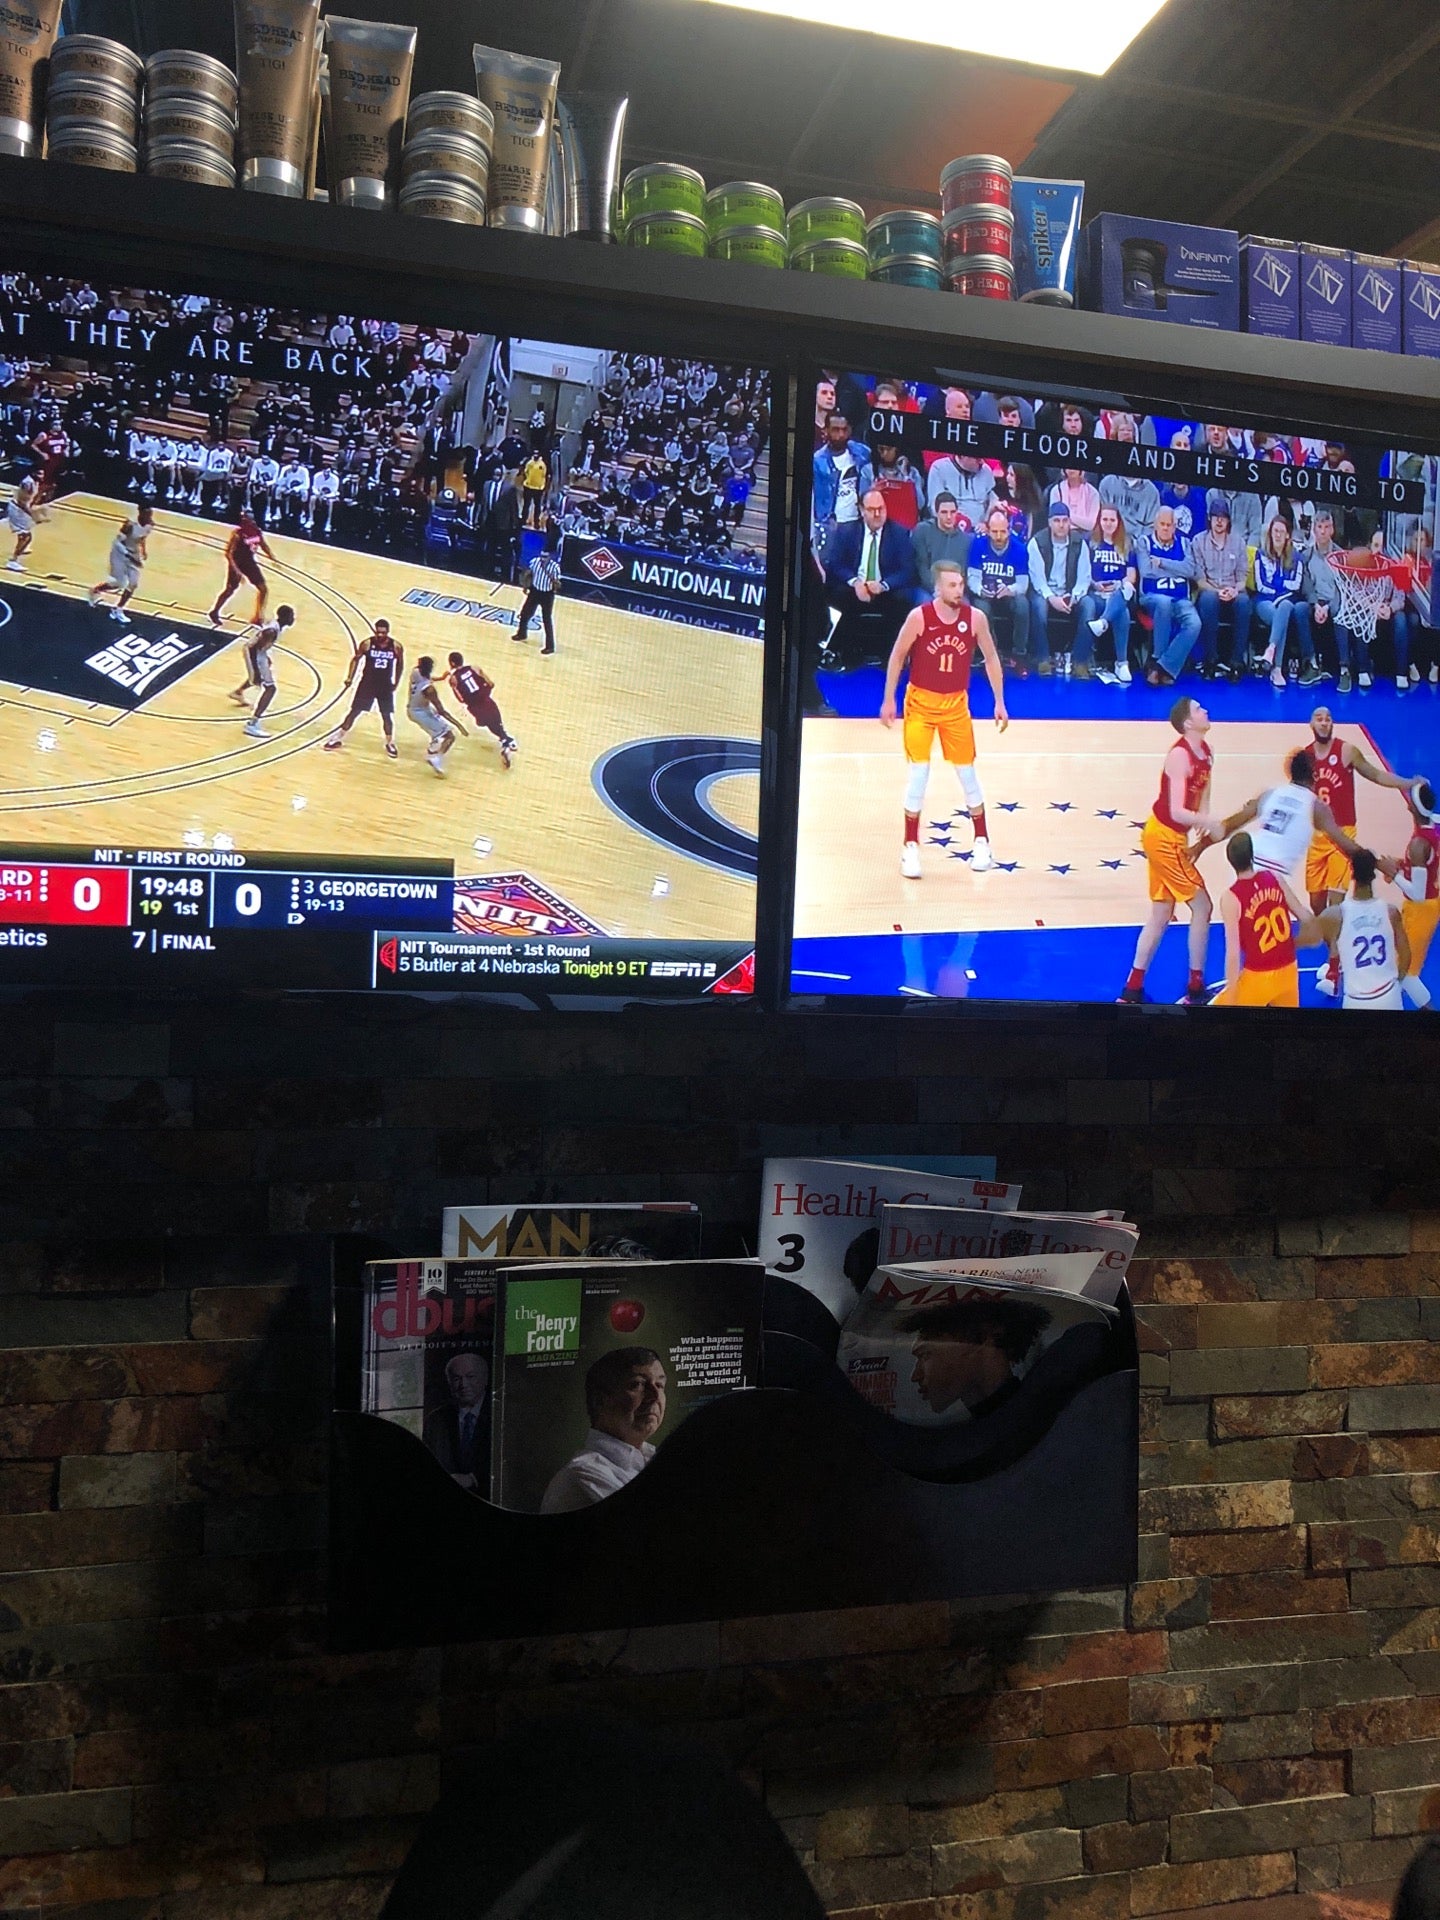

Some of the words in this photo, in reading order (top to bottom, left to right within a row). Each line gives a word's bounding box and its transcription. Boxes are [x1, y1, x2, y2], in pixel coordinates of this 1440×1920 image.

[367, 75, 401, 87] HEAD
[495, 102, 520, 115] BED
[521, 107, 543, 119] HEA
[1033, 210, 1053, 268] spiker
[1188, 251, 1233, 264] INFINITY
[977, 278, 1005, 292] HEAD
[65, 318, 157, 352] THEY
[188, 335, 254, 365] ARE
[286, 347, 372, 379] BACK
[870, 411, 904, 435] ON
[929, 419, 979, 445] THE
[1003, 429, 1104, 465] FLOOR,
[1127, 446, 1176, 472] AND
[1197, 456, 1260, 482] HE'S
[1280, 469, 1357, 497] GOING
[1379, 480, 1406, 503] TO
[631, 560, 736, 601] NATIONAL
[741, 583, 766, 607] IN
[84, 633, 151, 675] BIG
[107, 632, 189, 688] EAST
[374, 658, 389, 669] 23
[939, 653, 953, 673] 11
[1318, 787, 1331, 806] 6
[95, 849, 122, 863] NIT
[137, 851, 182, 865] FIRST
[186, 854, 246, 867] ROUND
[0, 869, 33, 886] RD
[73, 877, 101, 911] 0
[140, 878, 204, 897] 19:48
[304, 881, 314, 895] 3
[319, 881, 438, 899] GEORGETOWN
[140, 900, 162, 916] 19
[174, 900, 199, 916] 1st
[235, 882, 262, 915] 0
[304, 898, 345, 912] 19-13
[0, 930, 48, 947] etics
[1253, 906, 1291, 954] 20
[132, 931, 147, 949] 7
[163, 935, 216, 951] FINAL
[400, 940, 427, 955] NIT
[429, 940, 512, 957] Tournament
[524, 943, 544, 957] 1st
[547, 944, 590, 958] Round
[1352, 934, 1387, 969] 23
[400, 957, 410, 972] 5
[413, 957, 458, 974] Butler
[461, 960, 477, 973] at
[479, 958, 489, 973] 4
[494, 959, 560, 975] Nebraska
[562, 960, 615, 979] Tonight
[617, 961, 626, 976] 9
[629, 962, 648, 977] ET
[772, 1184, 889, 1218] Health
[458, 1211, 592, 1258] MAN
[887, 1226, 1009, 1260] Detroit
[773, 1233, 806, 1273] 3
[427, 1268, 443, 1279] 10
[873, 1276, 1010, 1306] MAN
[515, 1306, 538, 1320] the
[536, 1314, 577, 1333] Henry
[527, 1331, 565, 1353] Ford
[669, 1346, 694, 1354] when
[702, 1344, 743, 1353] professor
[681, 1337, 706, 1345] What
[707, 1335, 744, 1344] happens
[670, 1354, 680, 1362] of
[681, 1353, 715, 1363] physics
[716, 1352, 743, 1360] starts
[675, 1361, 709, 1372] playing
[710, 1359, 742, 1368] around
[677, 1376, 741, 1388] make-believe?
[688, 1370, 697, 1378] in
[706, 1368, 731, 1377] world
